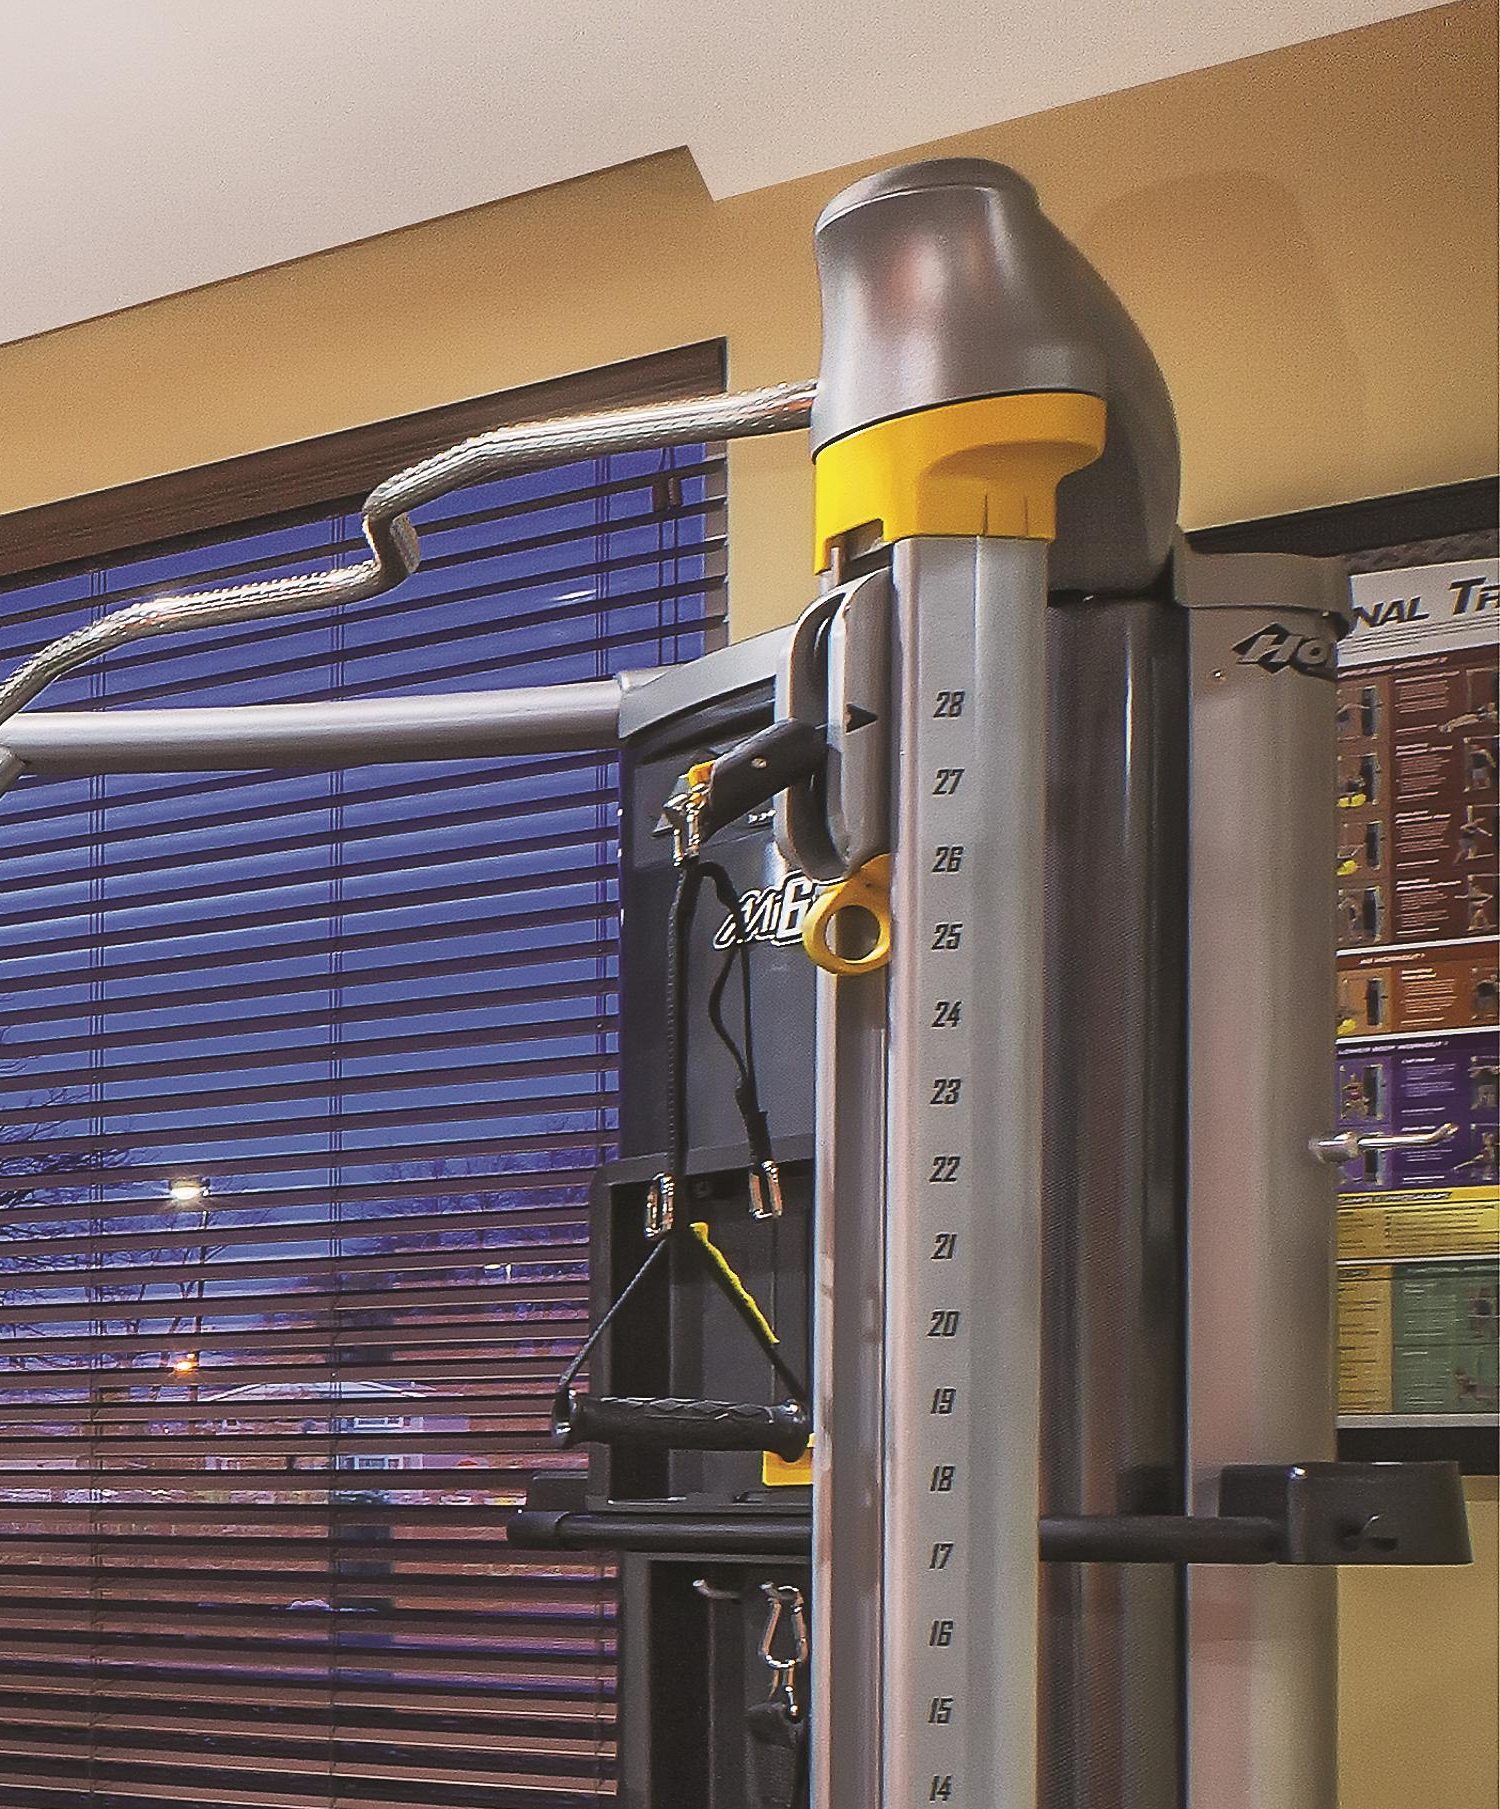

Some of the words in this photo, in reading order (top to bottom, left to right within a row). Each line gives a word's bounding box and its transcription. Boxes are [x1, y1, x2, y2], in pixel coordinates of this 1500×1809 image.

[932, 690, 966, 719] 28
[931, 768, 965, 795] 27
[931, 846, 964, 873] 26
[931, 923, 964, 951] 25
[931, 1000, 962, 1028] 24
[929, 1078, 962, 1105] 23
[928, 1156, 961, 1183] 22
[930, 1233, 958, 1260] 21
[926, 1309, 961, 1337] 20
[930, 1388, 957, 1415] 19
[929, 1465, 956, 1492] 18
[929, 1543, 954, 1571] 17
[929, 1620, 954, 1647] 16
[927, 1697, 955, 1724] 15
[929, 1775, 952, 1802] 14
